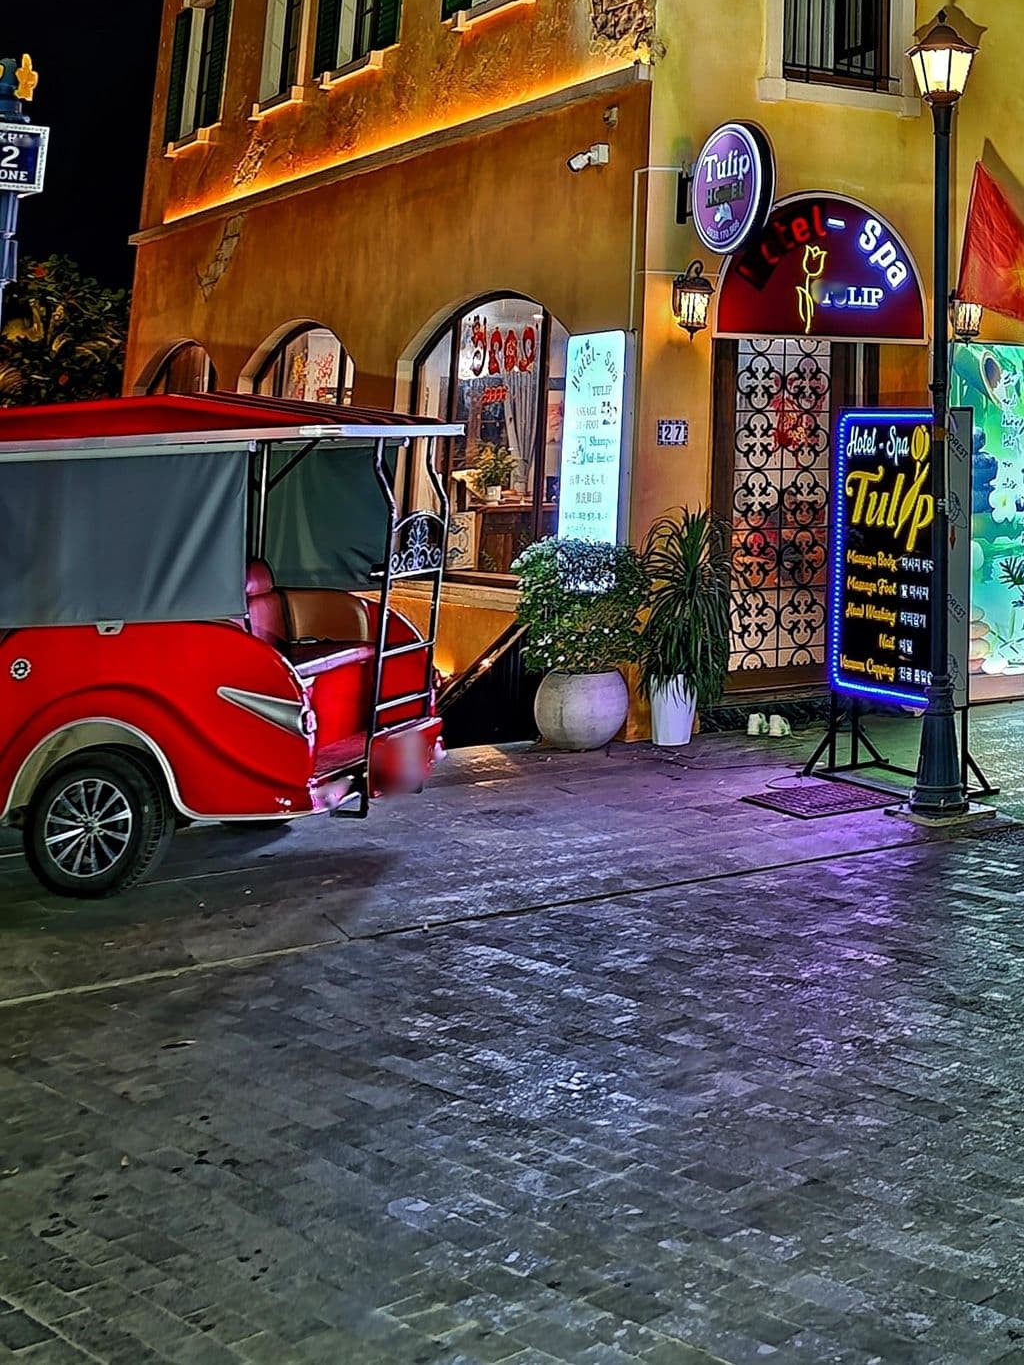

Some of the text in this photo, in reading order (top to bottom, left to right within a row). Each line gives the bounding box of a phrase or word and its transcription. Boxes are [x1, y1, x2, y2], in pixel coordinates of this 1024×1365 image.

[0, 169, 28, 181] ONE
[703, 149, 751, 182] Tulip
[858, 219, 907, 288] Spa
[664, 425, 682, 440] 27
[846, 425, 877, 457] Hotel
[886, 424, 910, 466] Spa
[946, 433, 968, 459] OREST
[877, 551, 898, 572] Body
[877, 578, 897, 595] Foot
[946, 593, 966, 619] OREST
